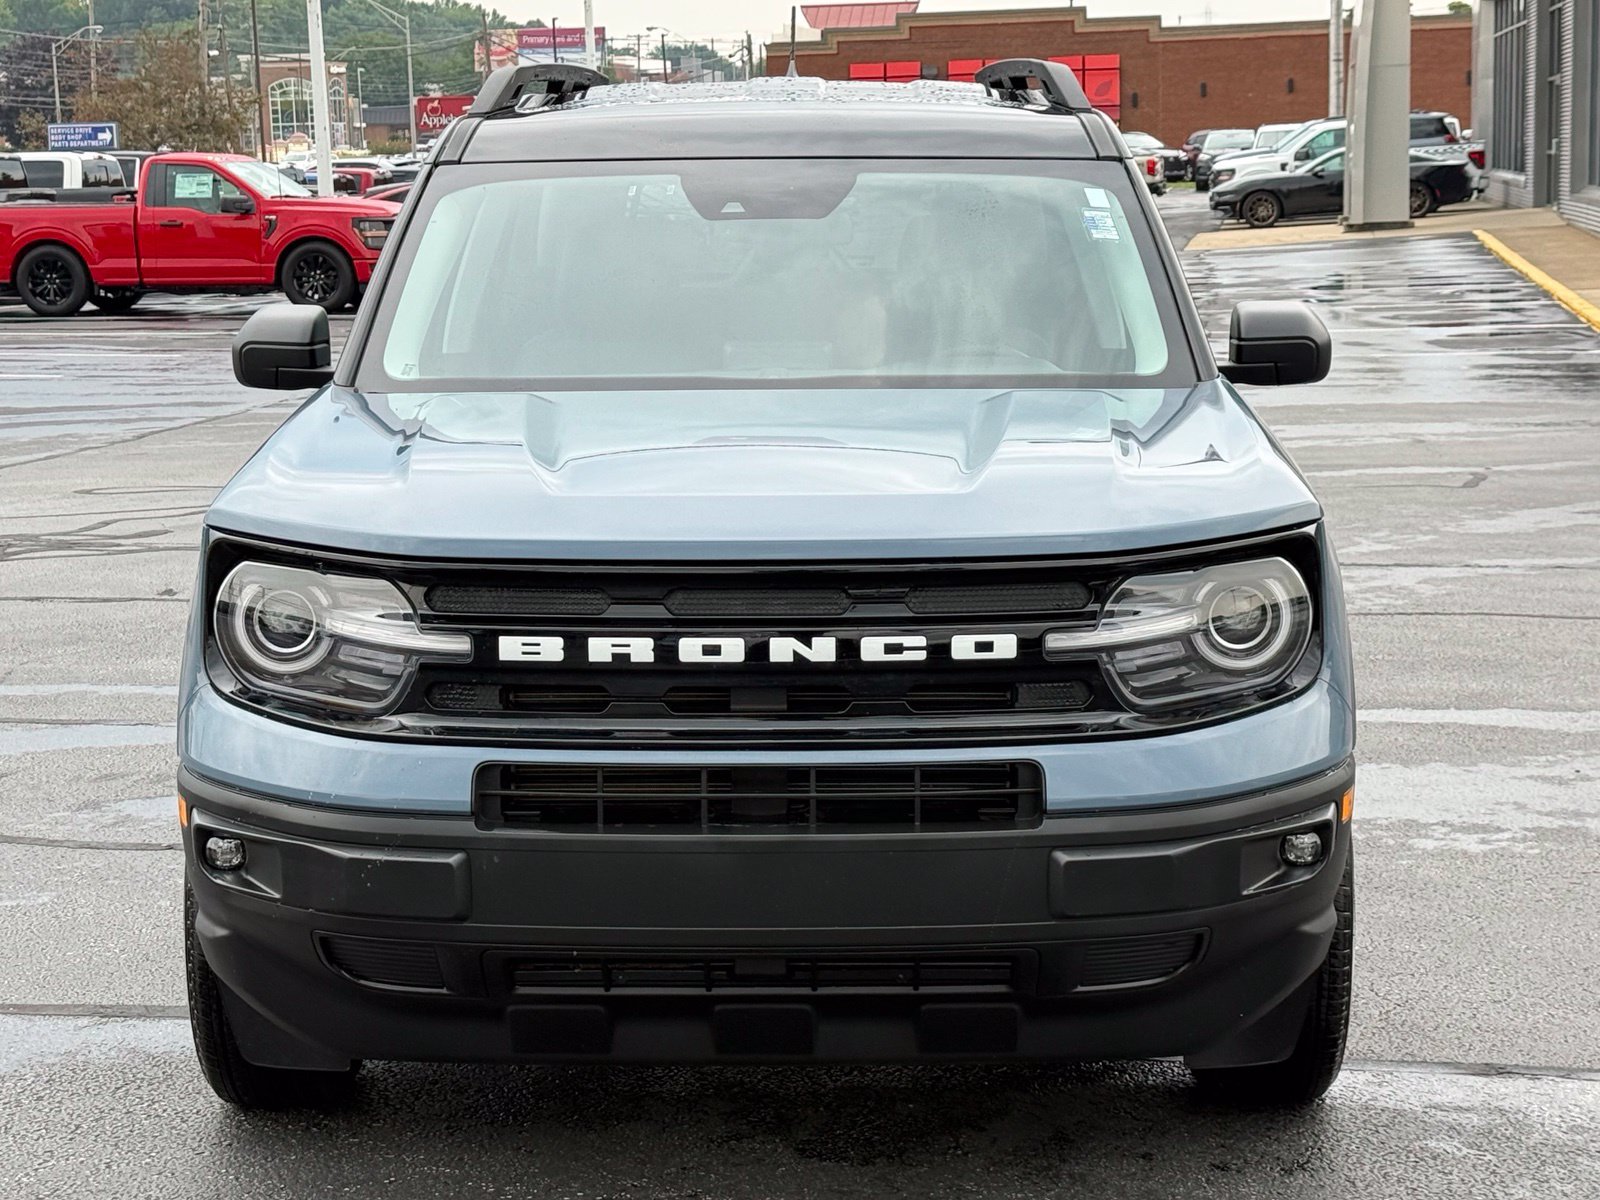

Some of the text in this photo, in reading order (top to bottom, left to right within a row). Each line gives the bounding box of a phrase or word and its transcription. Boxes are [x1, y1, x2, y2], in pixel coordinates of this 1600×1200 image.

[522, 35, 549, 45] Primary
[566, 33, 580, 42] and
[498, 633, 1018, 663] BRONCO
